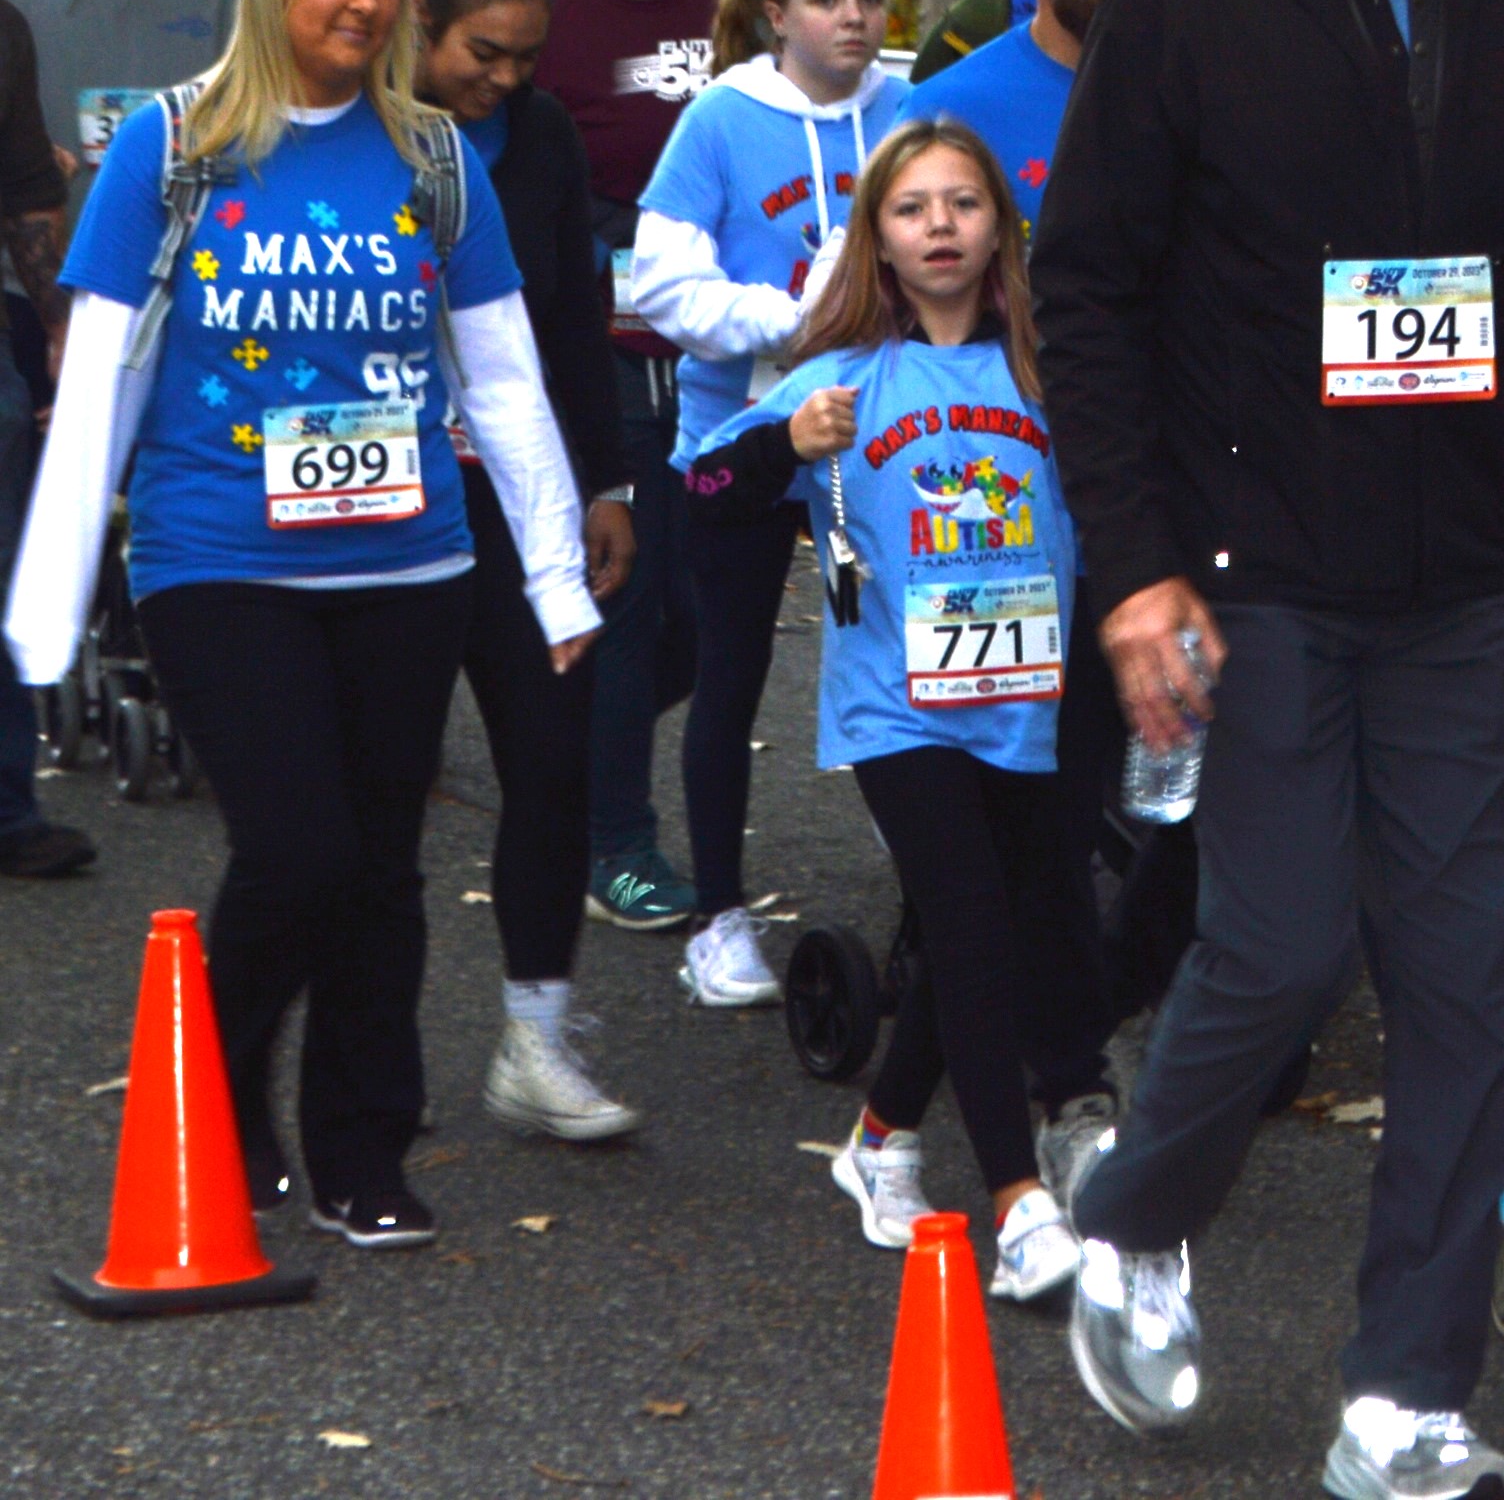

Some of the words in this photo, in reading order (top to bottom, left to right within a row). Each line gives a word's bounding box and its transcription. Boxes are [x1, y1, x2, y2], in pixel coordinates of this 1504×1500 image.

[762, 174, 827, 220] MAX'
[240, 231, 398, 275] MAX'S
[202, 285, 428, 331] MANIACS
[1357, 307, 1461, 361] 194
[864, 405, 942, 470] MAX'S
[292, 441, 389, 490] 699
[909, 503, 1035, 557] AUTISM
[933, 620, 1023, 670] 771
